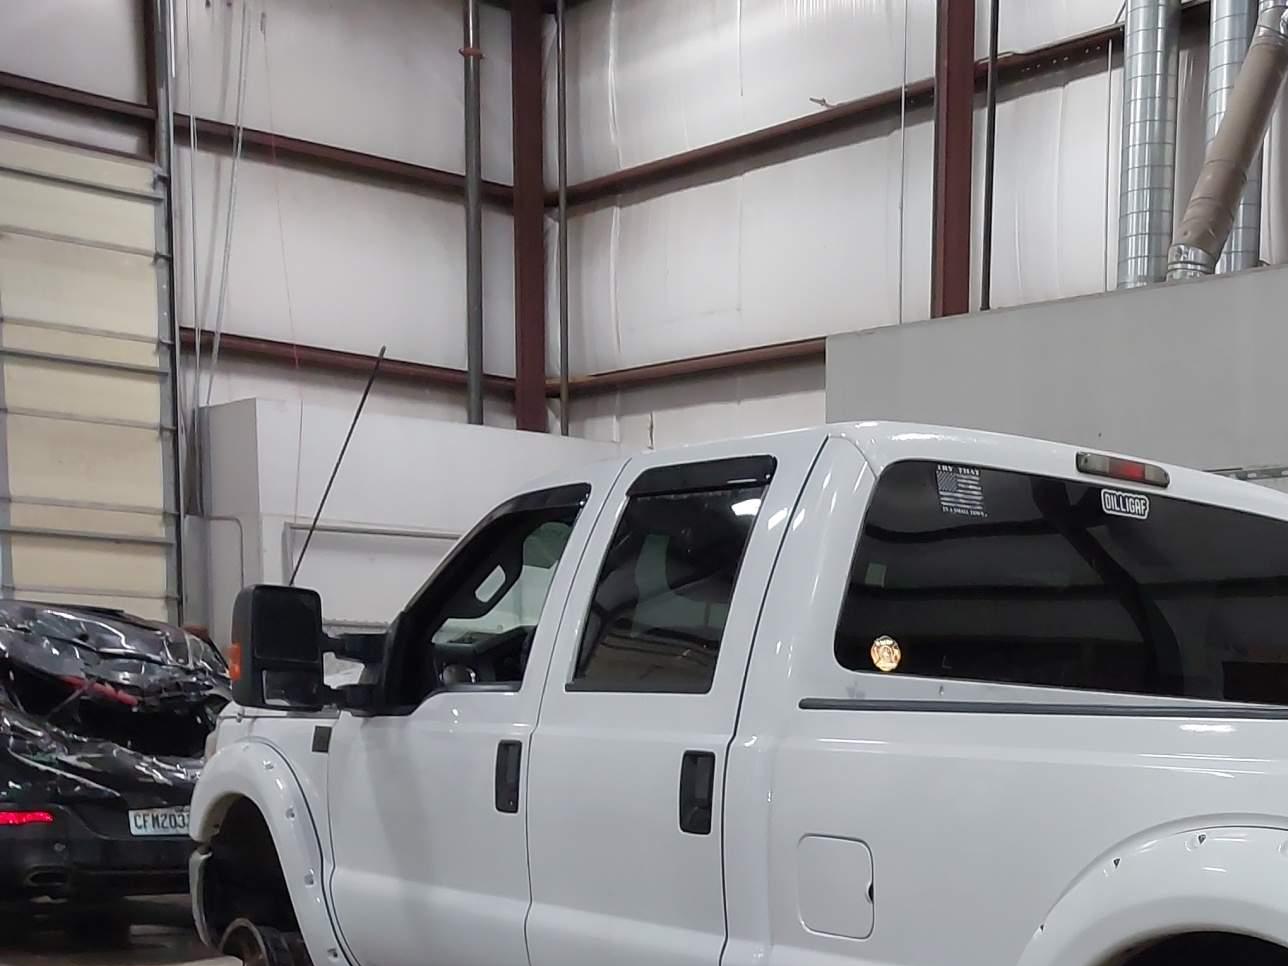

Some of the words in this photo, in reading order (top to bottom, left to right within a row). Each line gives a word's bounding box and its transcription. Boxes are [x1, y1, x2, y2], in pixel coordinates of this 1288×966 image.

[937, 464, 953, 473] TRY
[958, 467, 980, 477] THAT
[1105, 492, 1146, 515] DILLIGAF
[133, 813, 190, 830] CFM203
